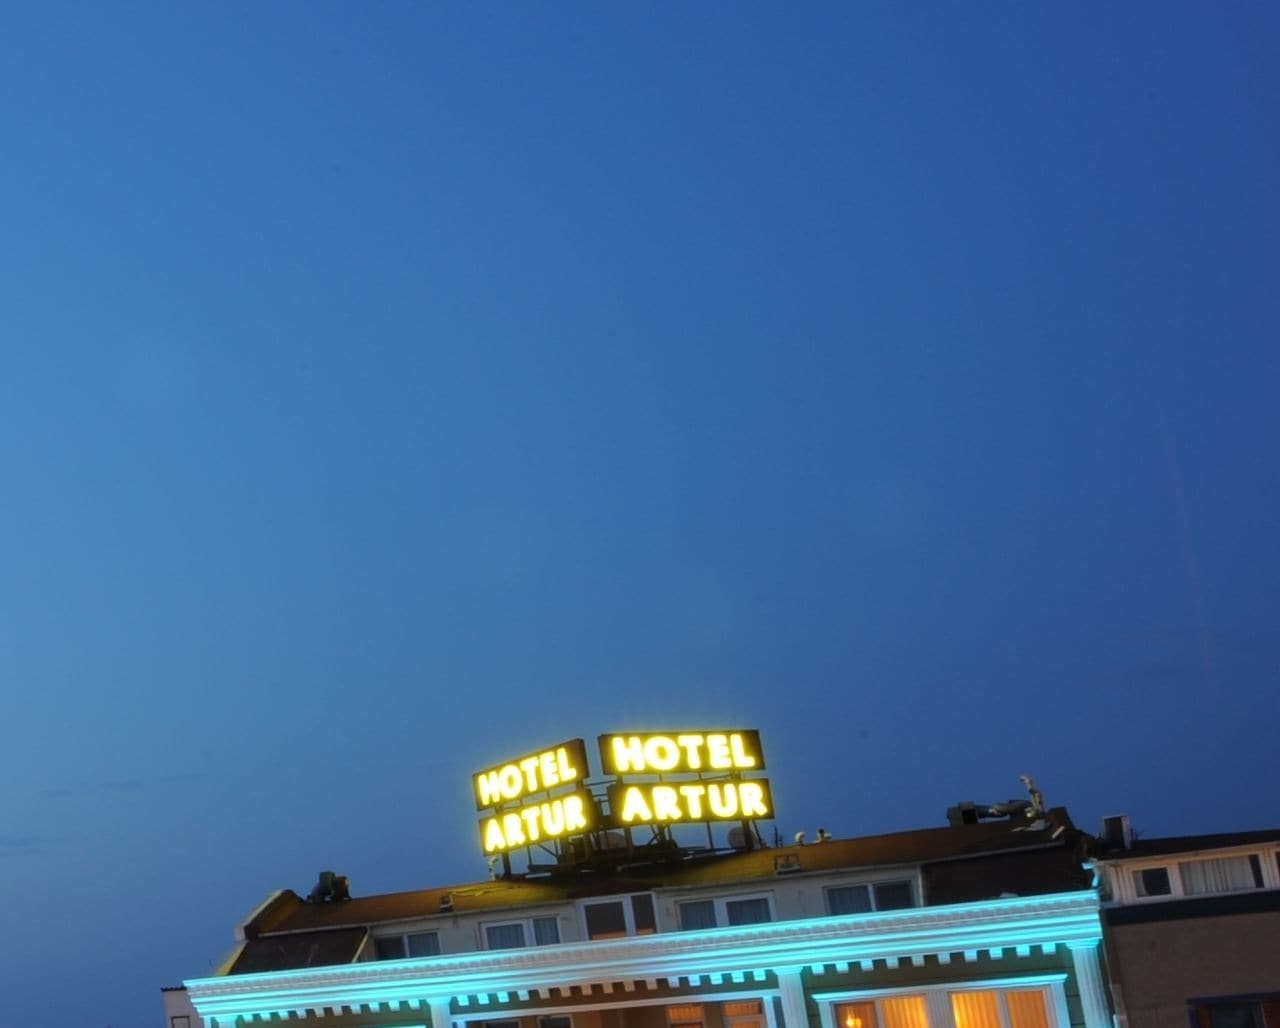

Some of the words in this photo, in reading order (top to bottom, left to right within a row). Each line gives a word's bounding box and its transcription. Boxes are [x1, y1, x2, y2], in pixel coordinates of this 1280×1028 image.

[477, 746, 578, 806] HOTEL
[611, 733, 756, 772] HOTEL
[484, 795, 587, 853] ARTUR
[621, 782, 769, 822] ARTUR
